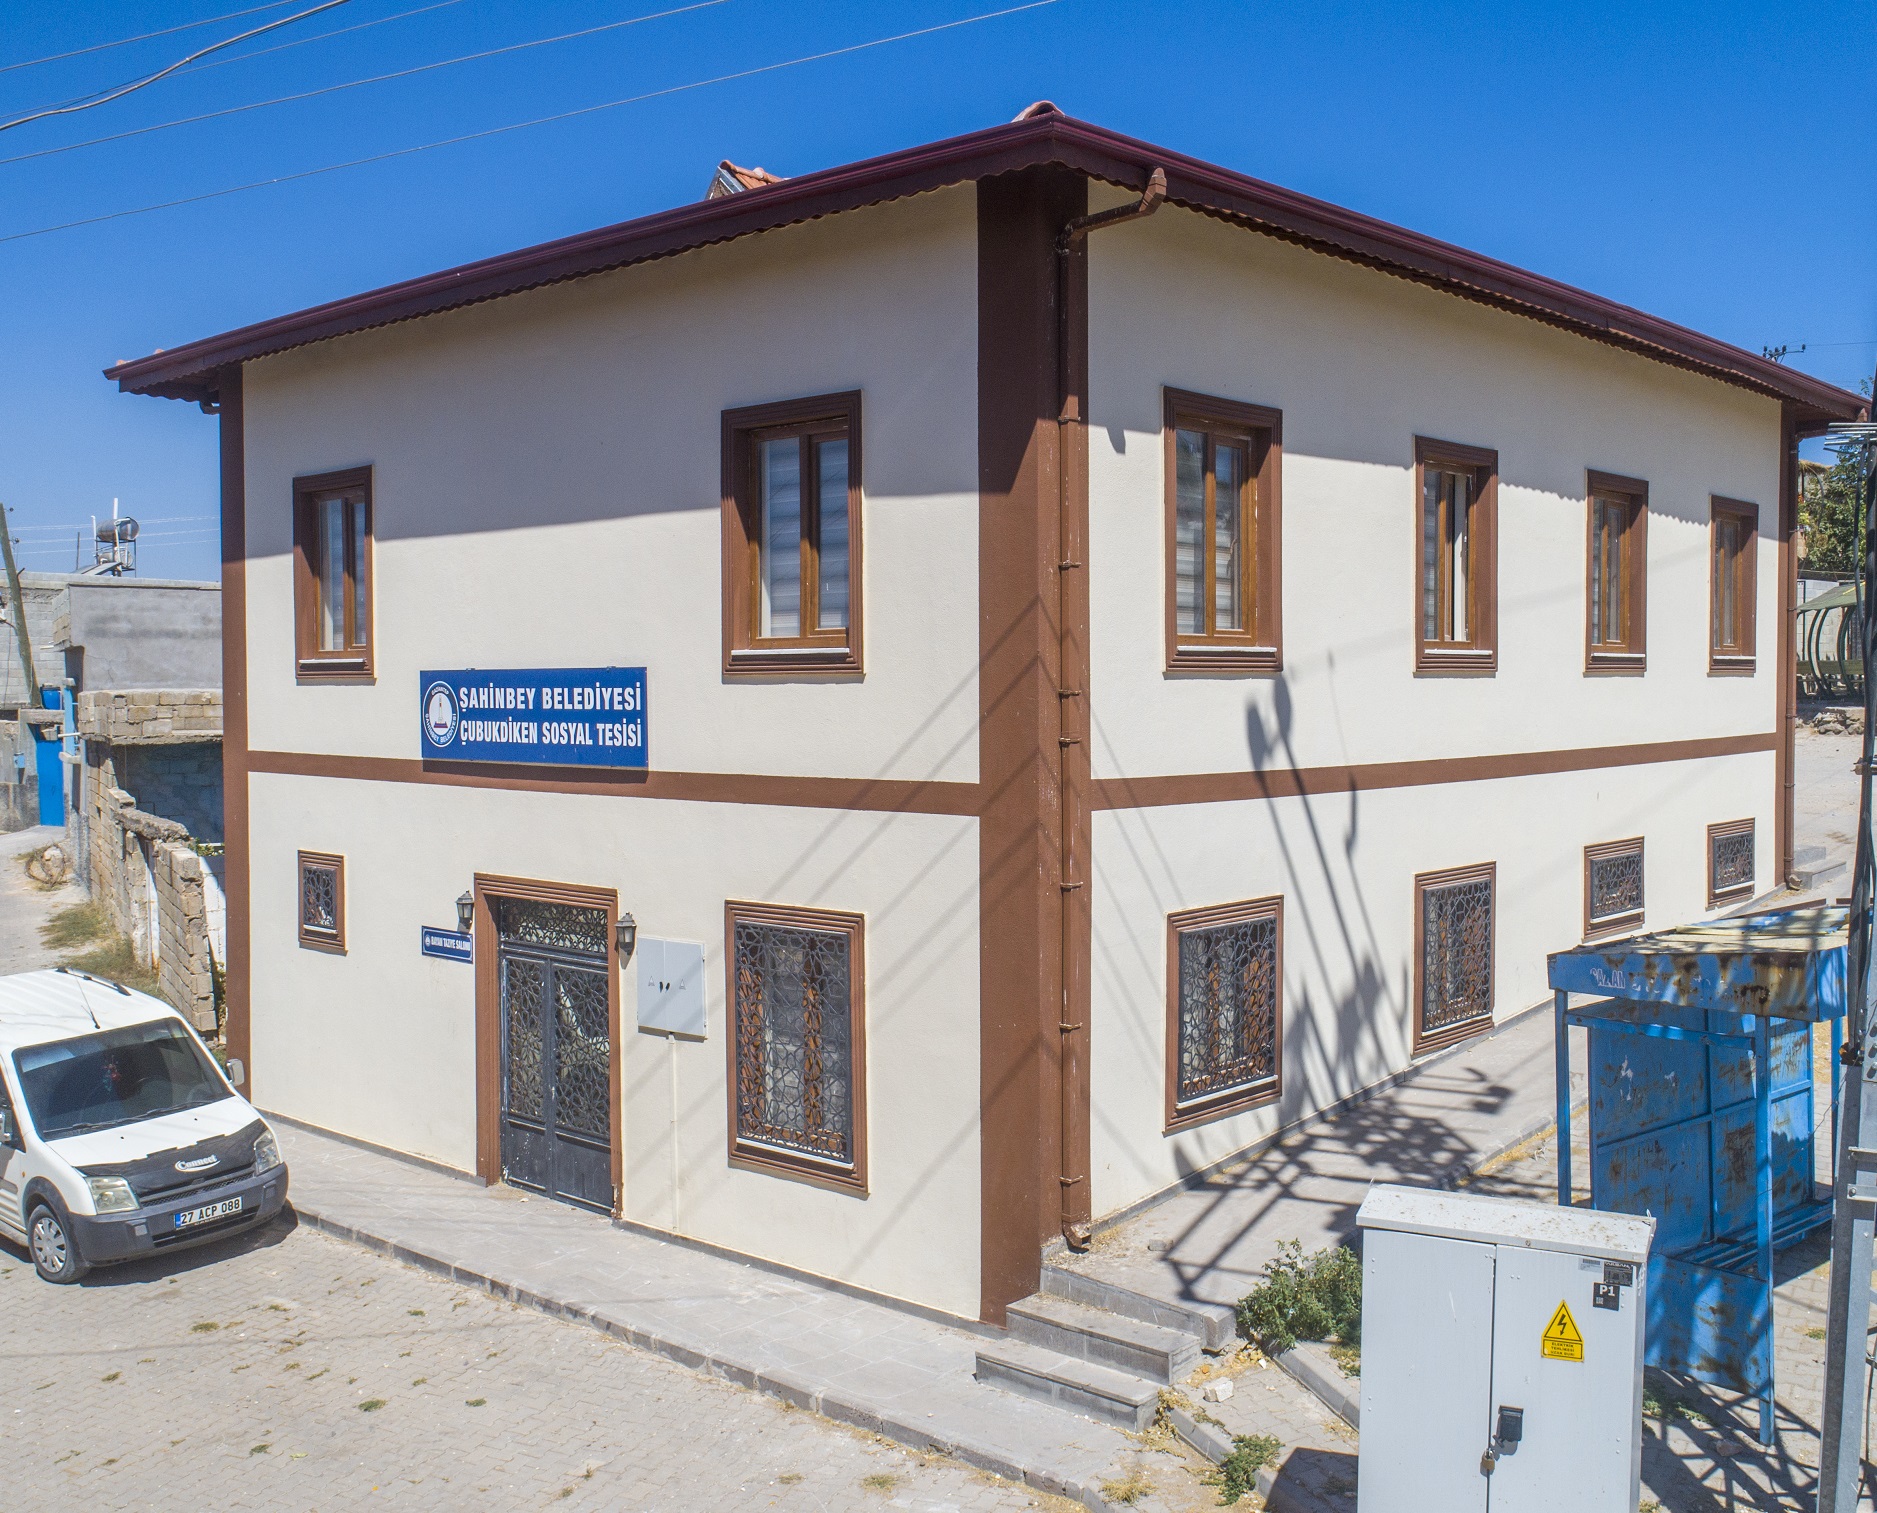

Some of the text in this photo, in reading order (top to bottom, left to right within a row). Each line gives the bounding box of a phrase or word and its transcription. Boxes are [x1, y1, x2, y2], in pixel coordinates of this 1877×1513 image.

[459, 682, 641, 712] ŞAHİNBEY BELEDİYESİ
[460, 716, 642, 747] ÇUBUKDİKEN SOSYAL TESİSİ
[178, 1154, 218, 1170] Connect
[181, 1211, 194, 1225] 27
[199, 1205, 218, 1219] ACP
[221, 1198, 240, 1213] 088
[1599, 1285, 1615, 1297] P1
